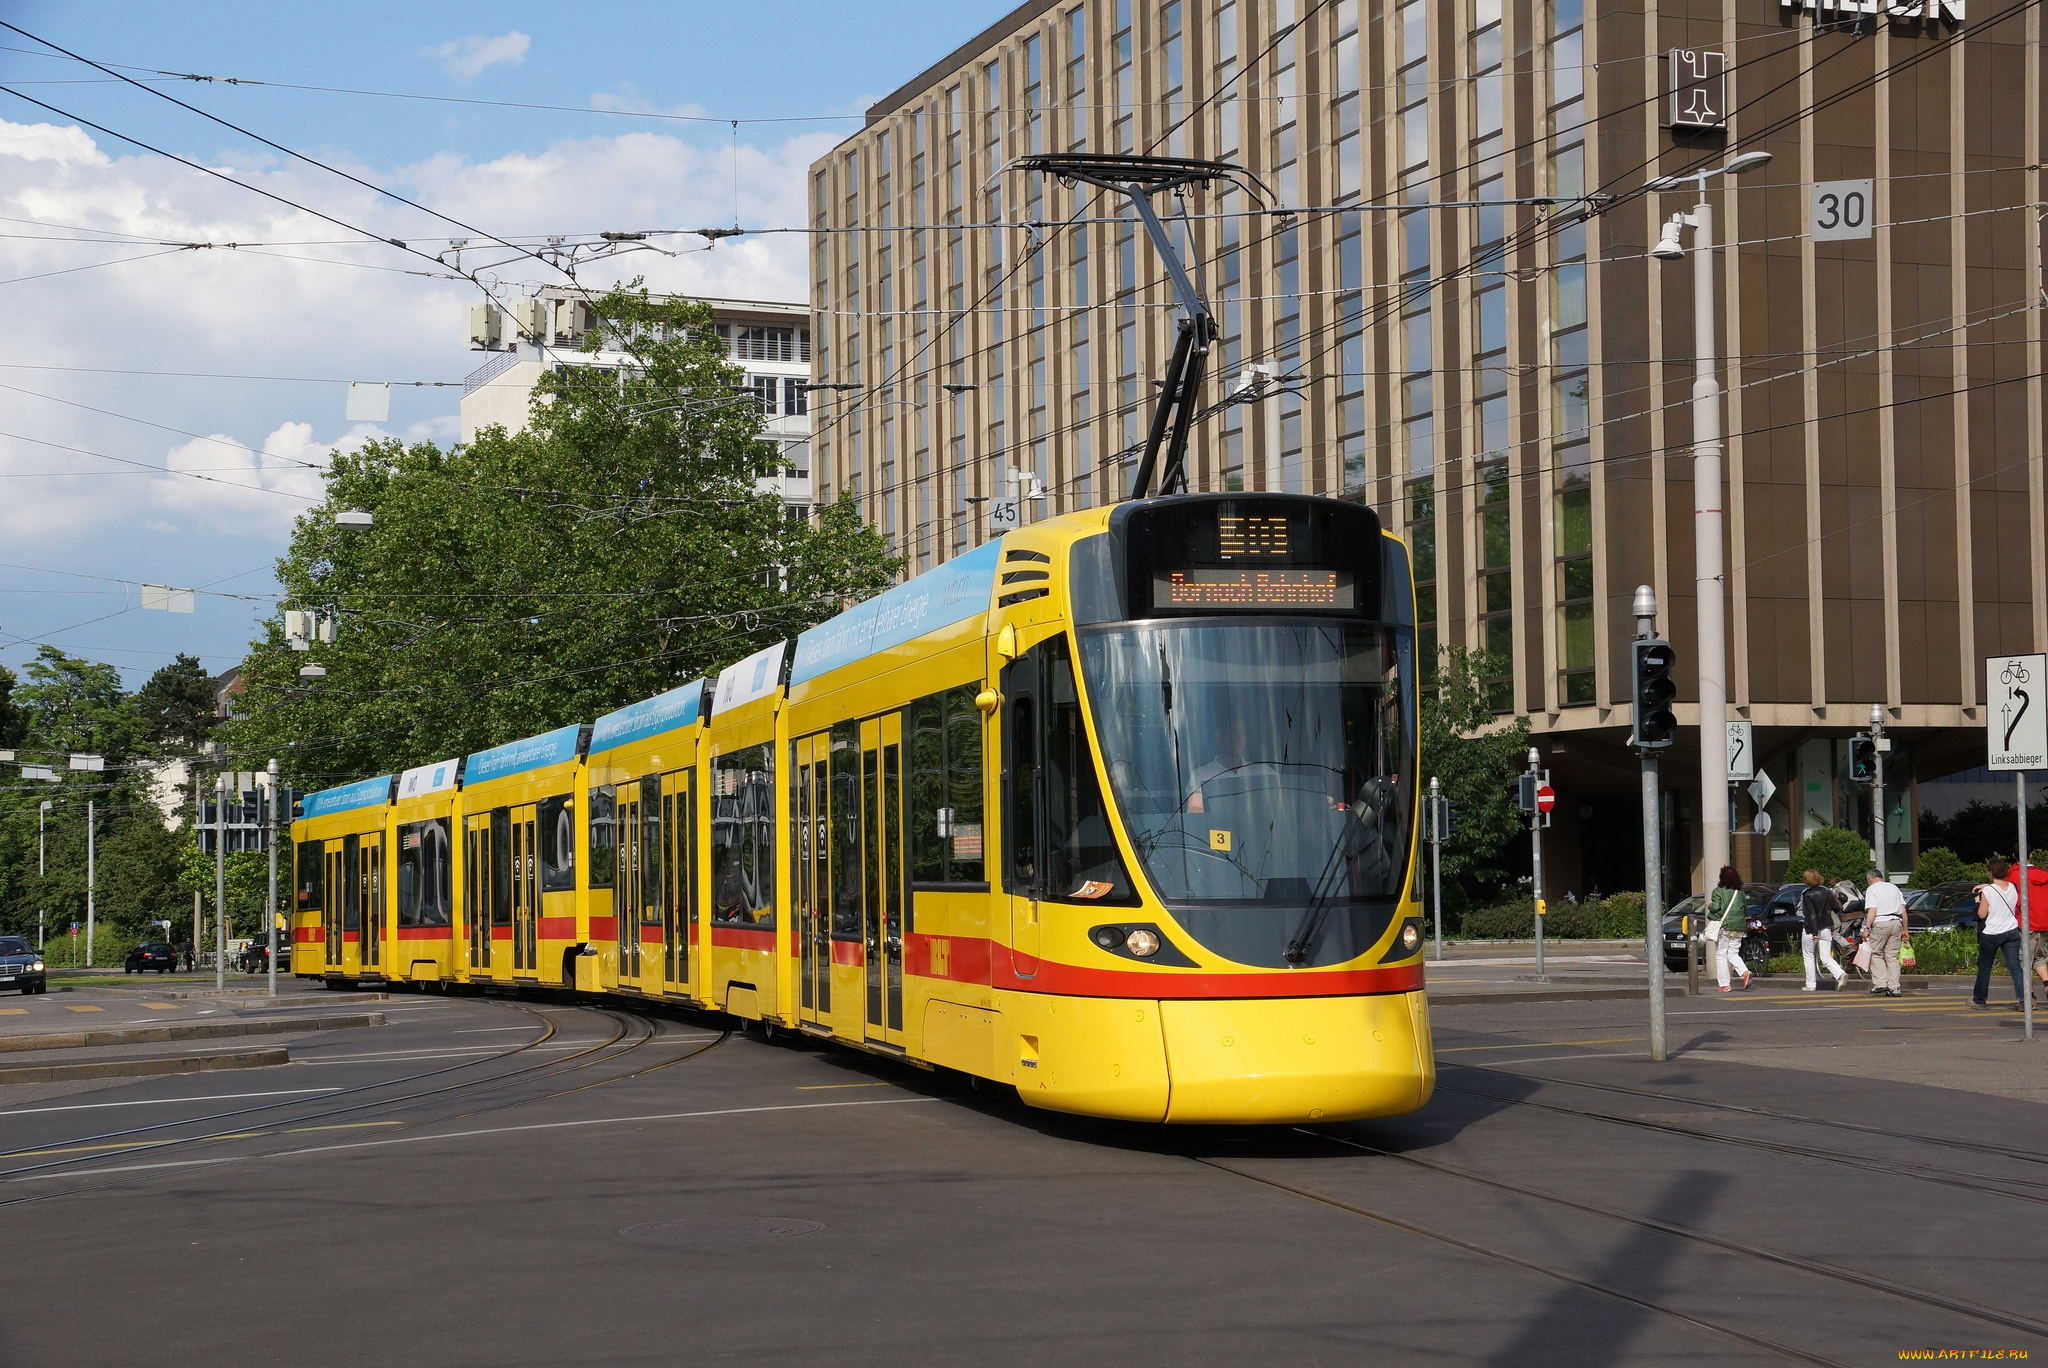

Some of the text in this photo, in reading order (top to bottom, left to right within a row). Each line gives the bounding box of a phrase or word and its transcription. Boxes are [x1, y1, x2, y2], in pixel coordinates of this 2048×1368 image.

[1817, 191, 1865, 229] 30
[994, 503, 1016, 522] 45
[1257, 573, 1336, 602] Bahnhof
[1991, 753, 2043, 766] Linksabbieger
[1216, 833, 1225, 844] 3
